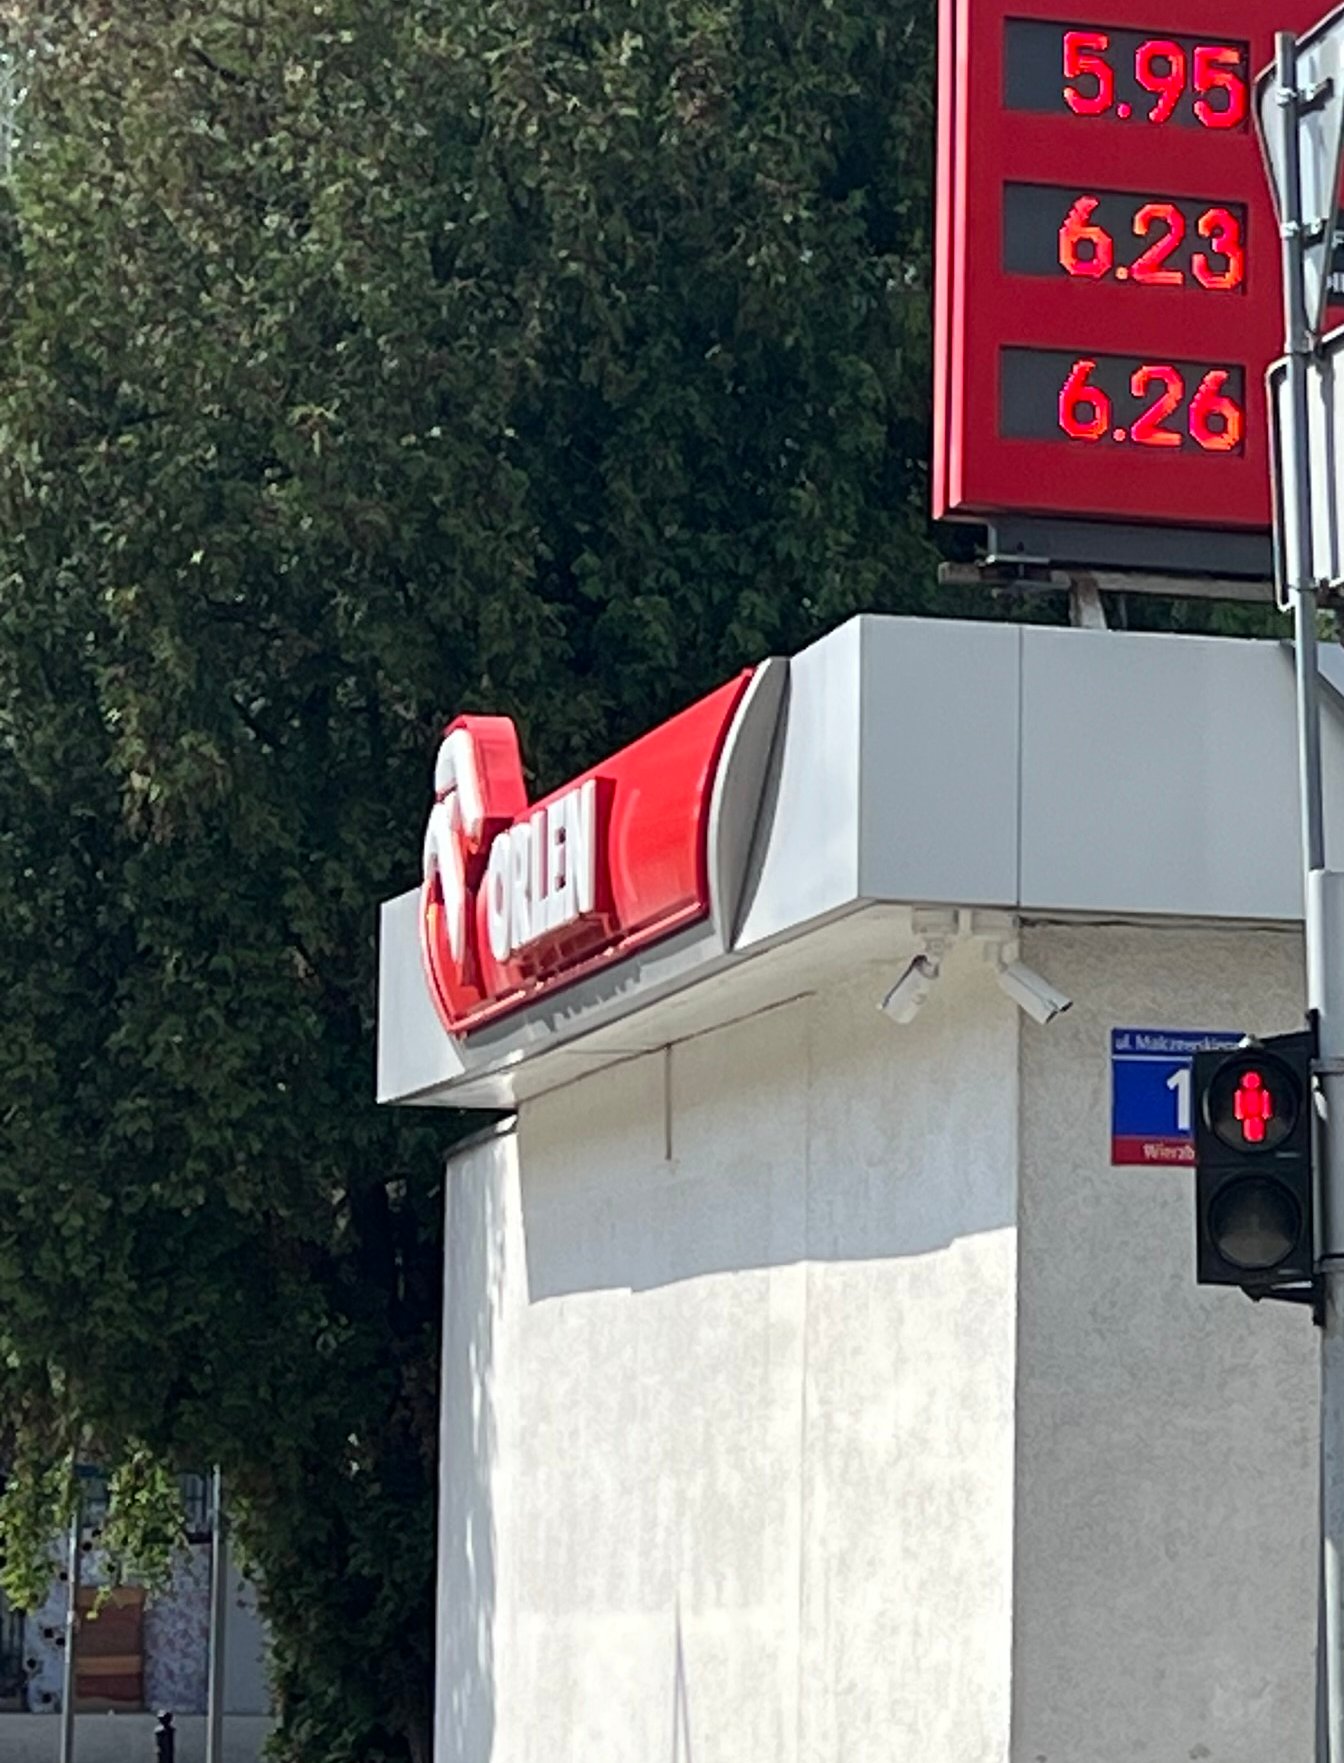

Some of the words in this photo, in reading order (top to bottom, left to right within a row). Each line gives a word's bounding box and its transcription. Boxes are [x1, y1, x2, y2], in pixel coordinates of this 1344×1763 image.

[1062, 30, 1248, 129] 5.95
[1057, 194, 1245, 292] 6.23
[1058, 358, 1242, 452] 6.26
[487, 777, 598, 963] ORLEN
